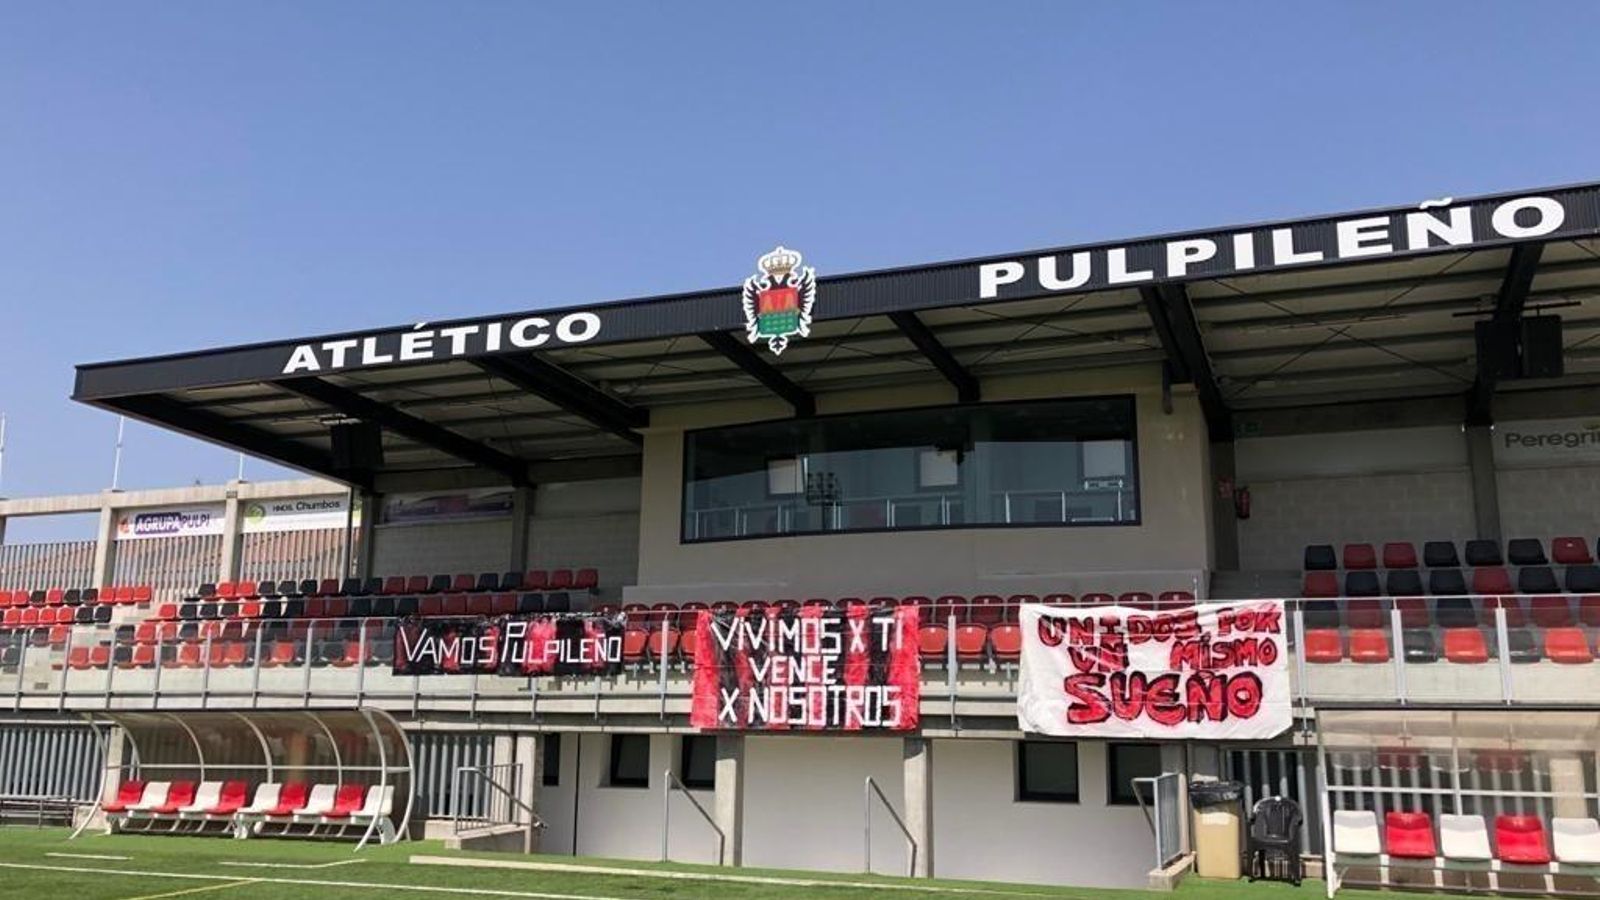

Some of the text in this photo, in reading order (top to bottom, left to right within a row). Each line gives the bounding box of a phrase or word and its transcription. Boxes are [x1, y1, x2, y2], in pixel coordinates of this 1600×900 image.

[282, 197, 1566, 374] ATLÉTICO PULPILEÑO
[1505, 431, 1600, 448] Peregri
[296, 499, 340, 511] Chumbos
[399, 626, 497, 665] VAMOS
[710, 617, 903, 653] VIVIMOS X TI
[749, 655, 839, 685] VENCE
[1067, 643, 1130, 673] UN
[718, 685, 902, 727] X NOSOTROS
[1064, 670, 1263, 727] SUEÑO
